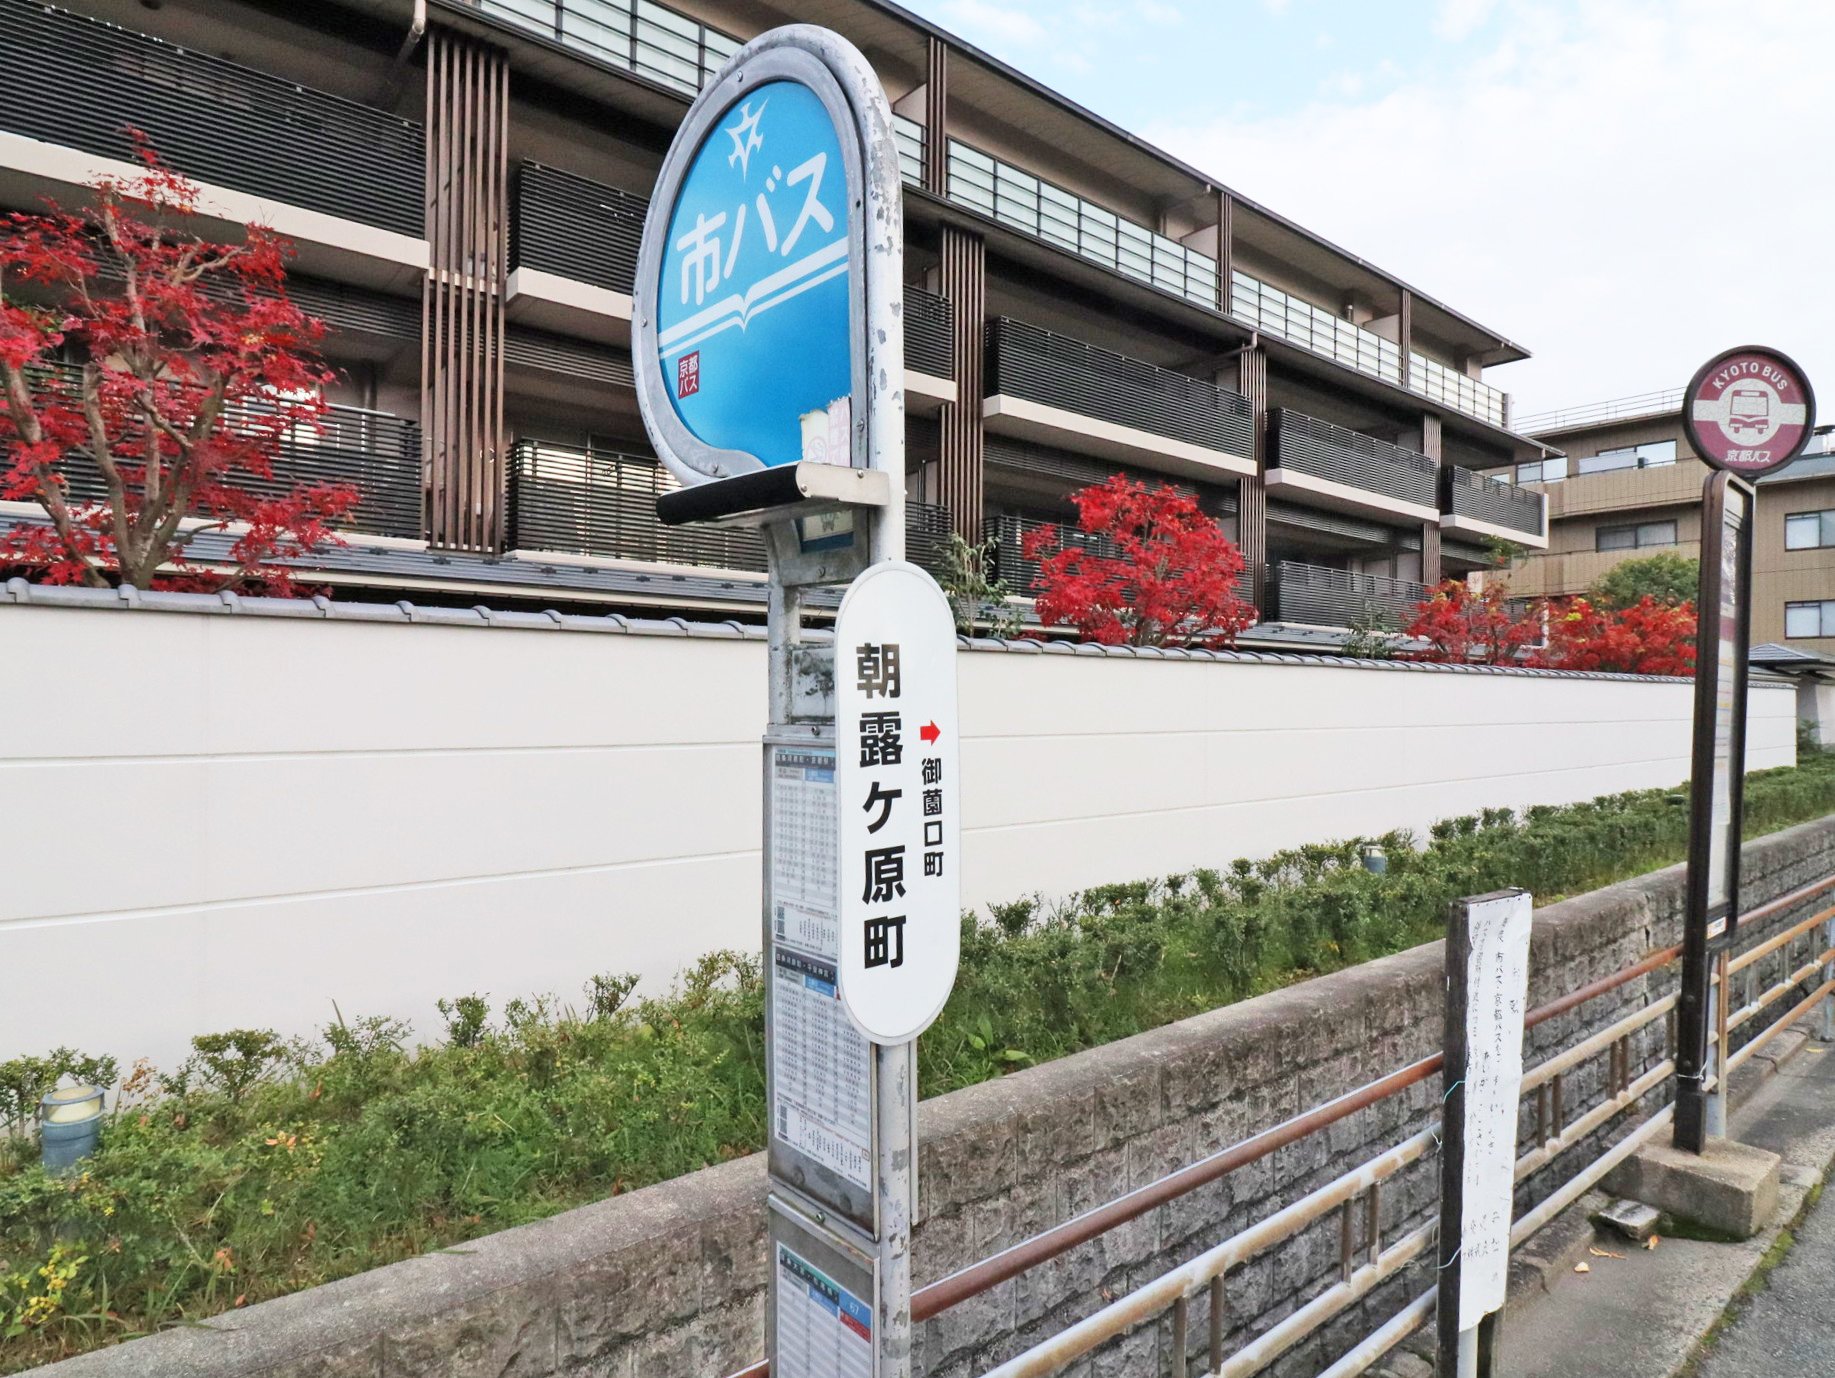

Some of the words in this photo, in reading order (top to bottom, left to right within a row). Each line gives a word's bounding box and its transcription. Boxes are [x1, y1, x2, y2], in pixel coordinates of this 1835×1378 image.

[677, 151, 834, 306] 市バス
[680, 355, 698, 378] 京都
[1712, 362, 1759, 390] KYOTO
[1762, 365, 1788, 390] BUS
[680, 374, 698, 396] バス
[1725, 449, 1771, 463] 京都バス
[921, 757, 943, 878] 御薗口町
